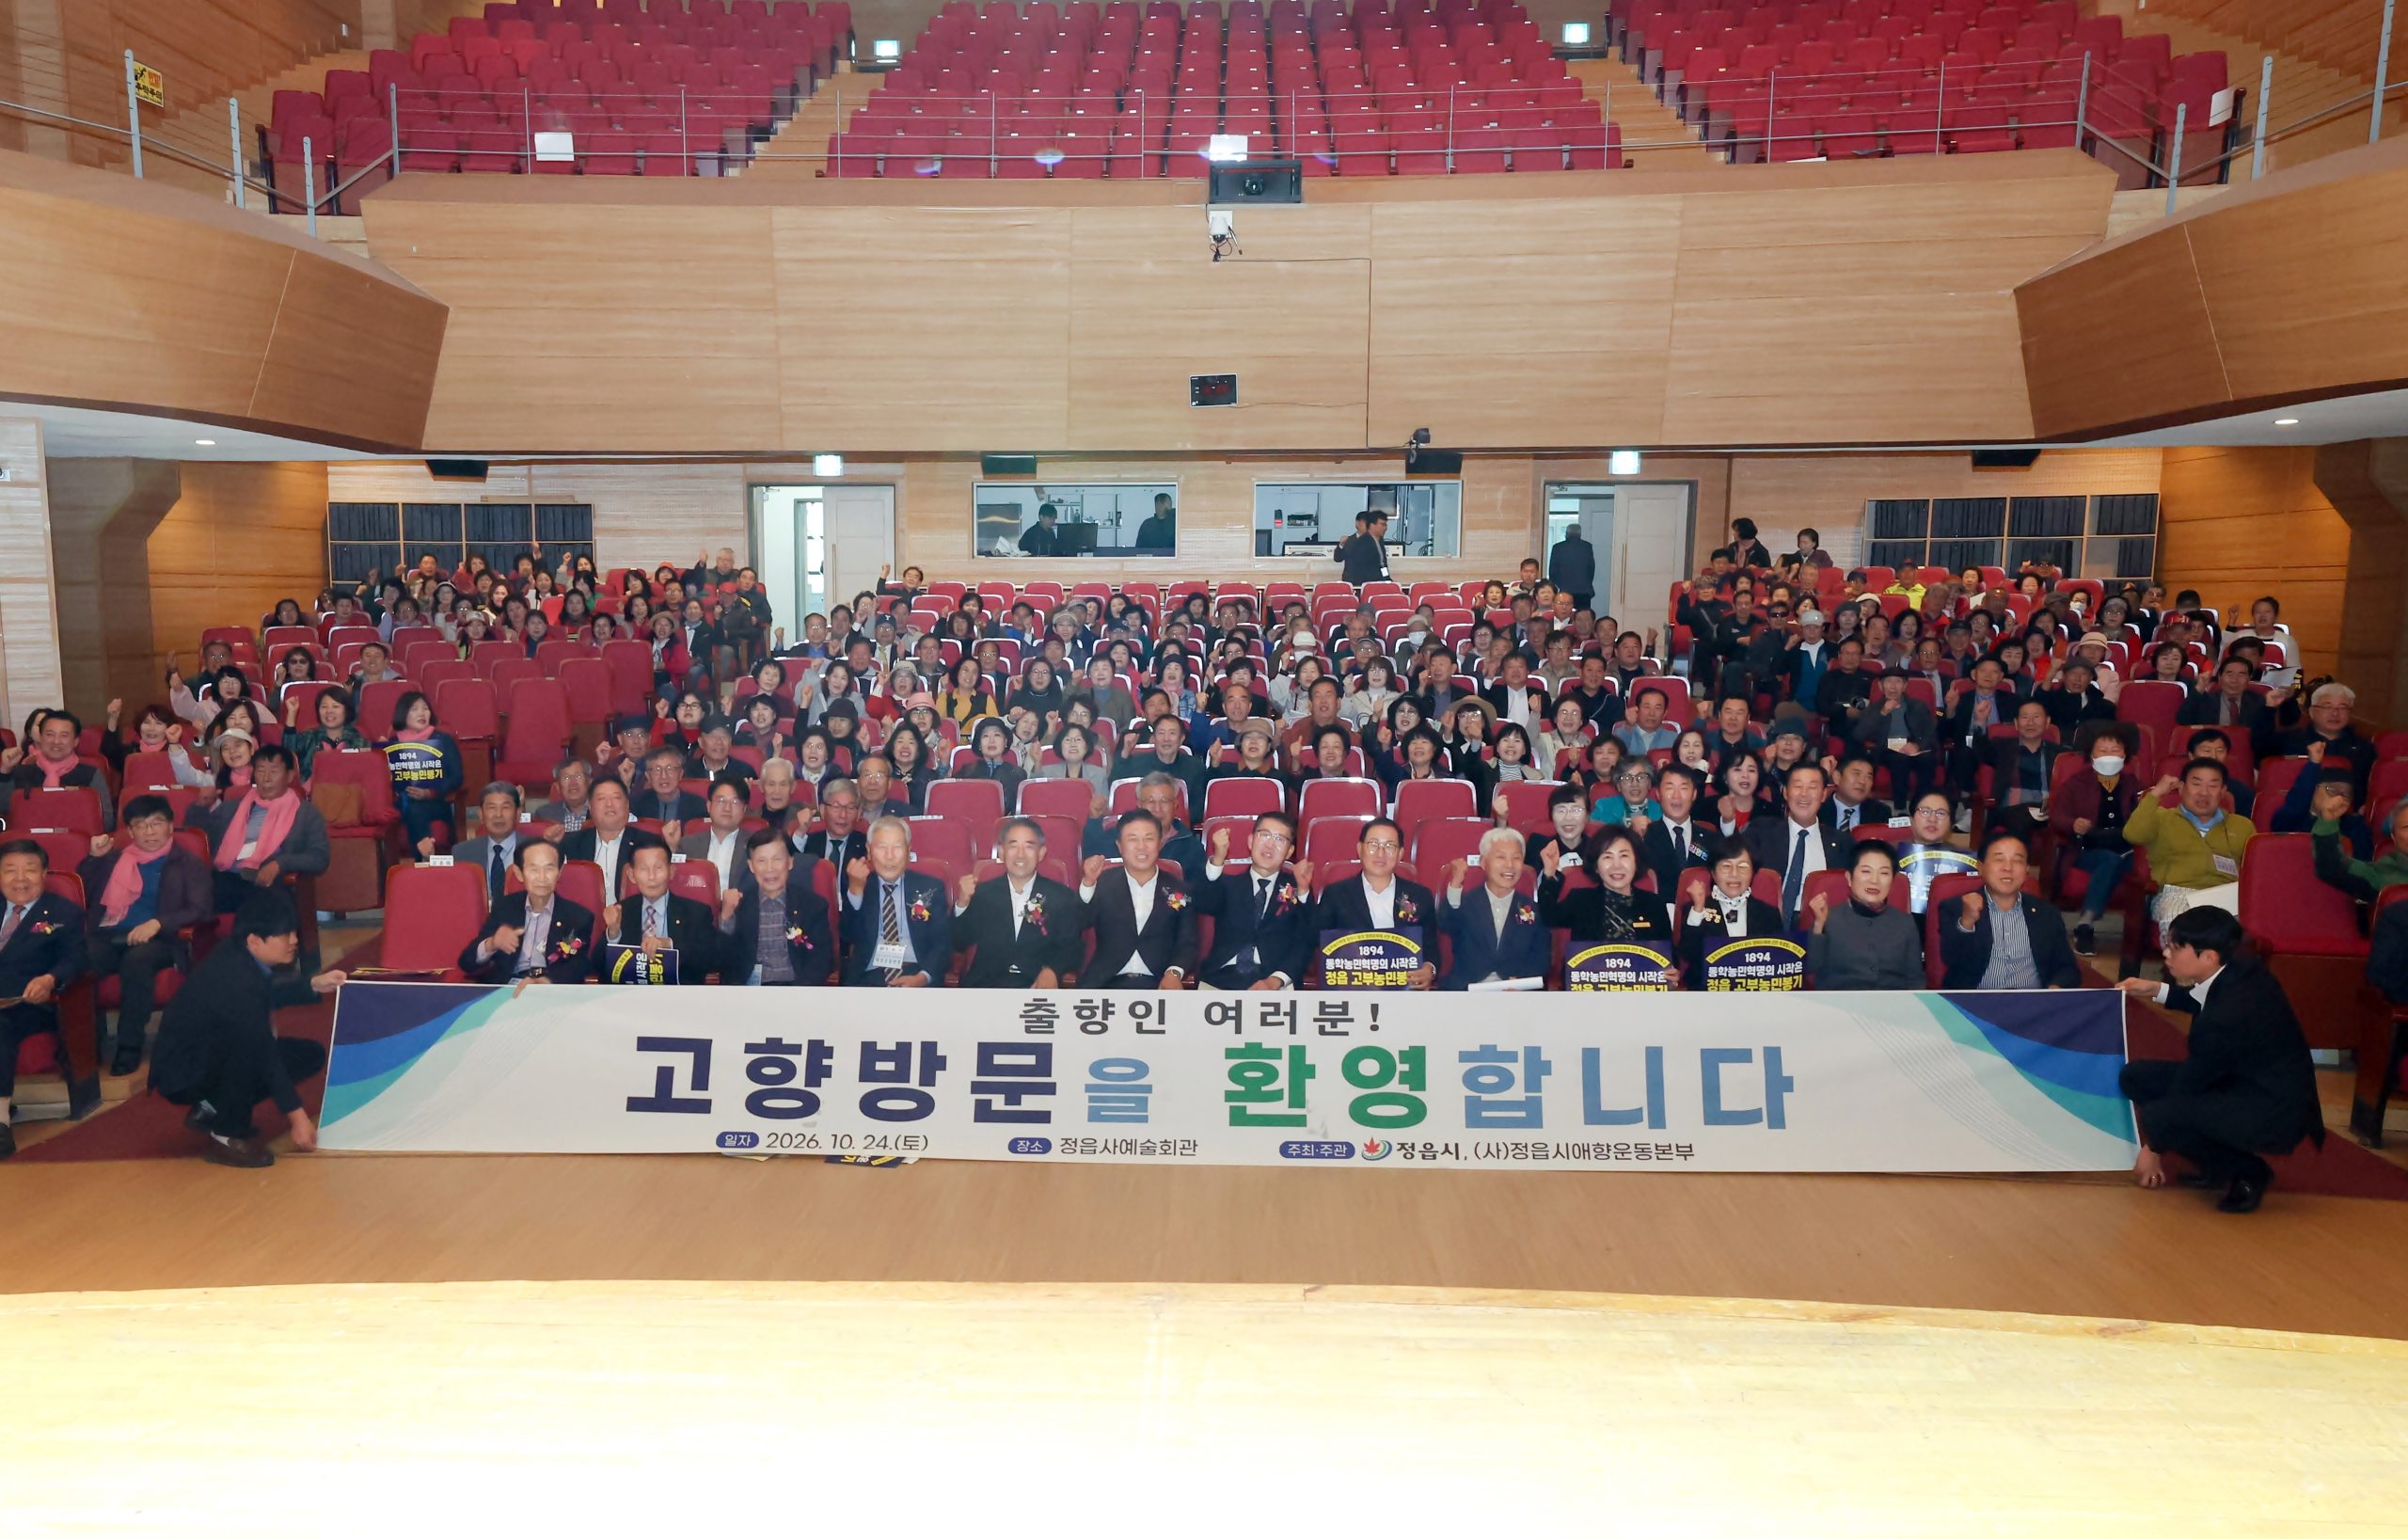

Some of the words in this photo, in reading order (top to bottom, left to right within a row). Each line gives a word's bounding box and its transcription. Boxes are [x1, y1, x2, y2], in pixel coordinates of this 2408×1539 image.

[421, 759, 442, 770] 시작은
[395, 769, 443, 782] 고부농민봉기
[1358, 945, 1385, 956] 1894
[1744, 952, 1771, 963] 1894
[1325, 958, 1388, 971] 동학농민혁명의
[1390, 957, 1418, 970] 시작은
[1605, 958, 1632, 969] 1894
[1707, 964, 1775, 978] 동학농민혁명의
[1777, 961, 1803, 976] 시작은
[1324, 970, 1349, 986] 정읍
[1351, 970, 1408, 987] 고부농민봉
[1570, 971, 1637, 983] 동학농민혁명의
[1639, 971, 1668, 983] 시작은
[1706, 978, 1731, 992] 정읍
[1734, 975, 1803, 992] 고부농민봉기
[1019, 997, 1166, 1036] 출향인
[1204, 999, 1381, 1037] 여러분!
[626, 1036, 1153, 1124] 고향방문을
[1224, 1041, 1794, 1131] 환영합니다
[724, 1134, 752, 1148] 일자
[765, 1132, 822, 1150] 2026.
[831, 1134, 855, 1150] 10.
[863, 1134, 928, 1152] 24.(토)
[1016, 1139, 1043, 1153] 장소
[1059, 1136, 1198, 1157] 정읍사예술회관
[1287, 1143, 1348, 1158] 주최·주관
[1396, 1141, 1468, 1161] 정읍시,
[1474, 1140, 1695, 1163] (사)정읍시애향운동본부
